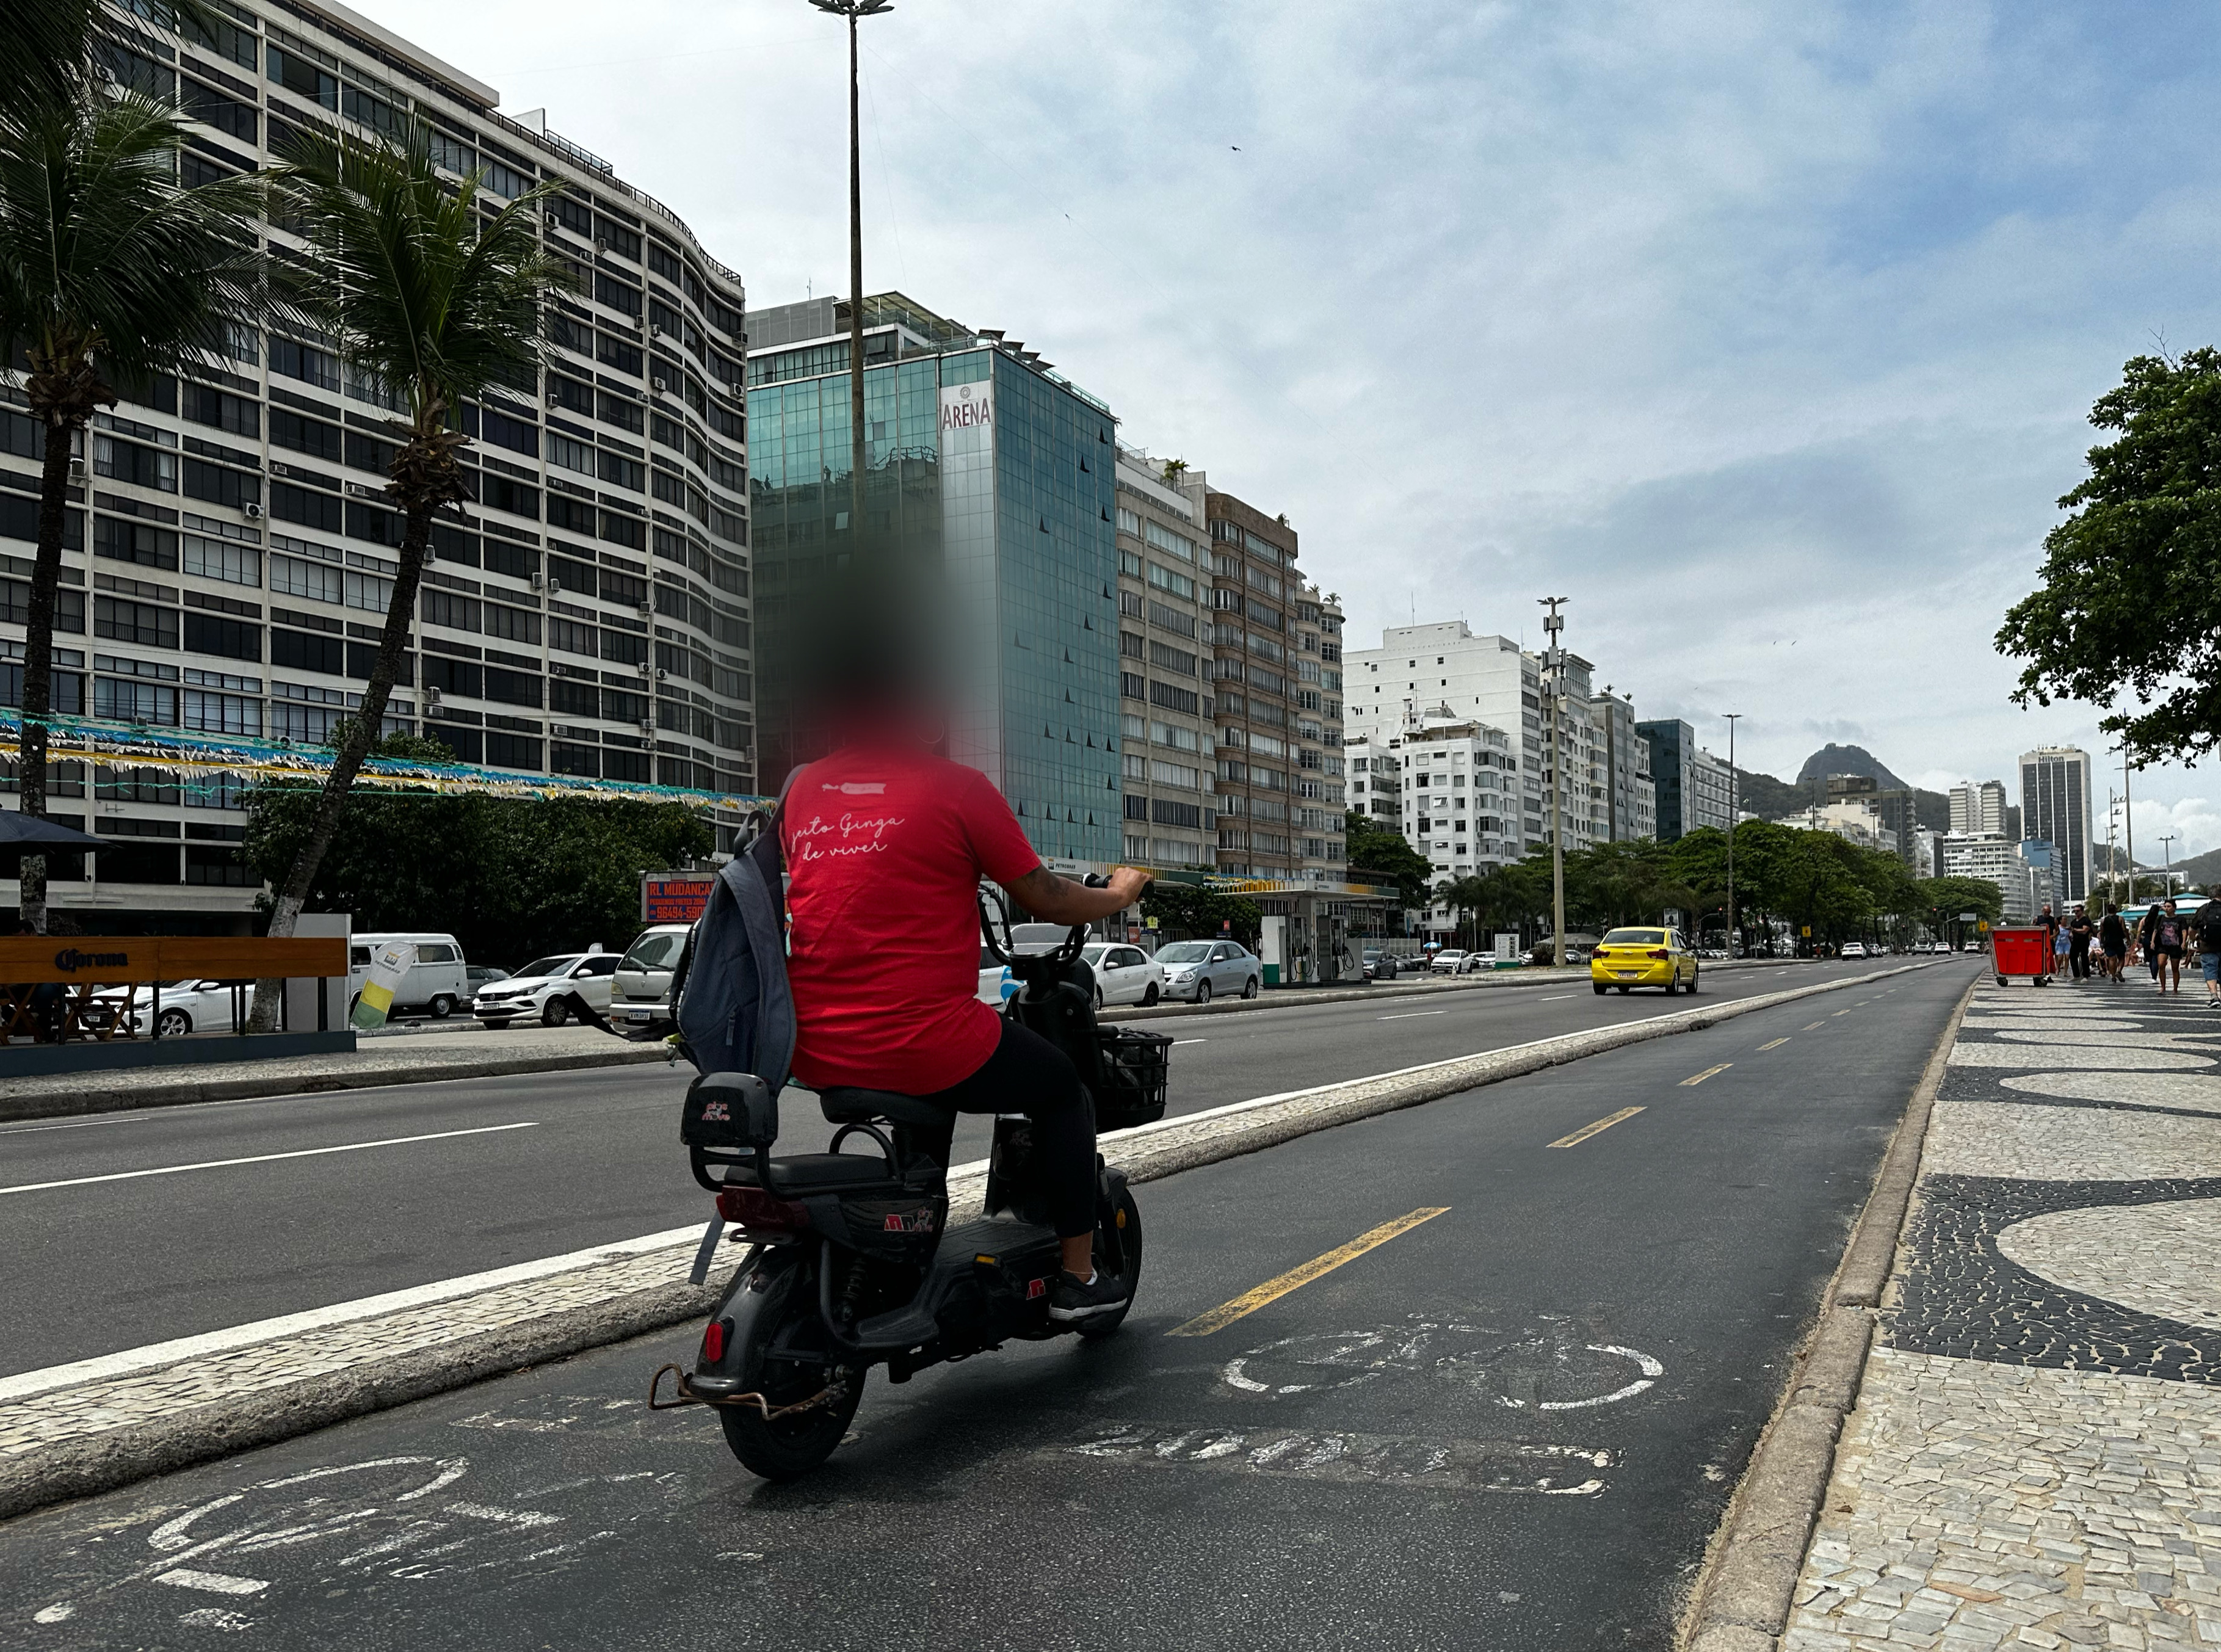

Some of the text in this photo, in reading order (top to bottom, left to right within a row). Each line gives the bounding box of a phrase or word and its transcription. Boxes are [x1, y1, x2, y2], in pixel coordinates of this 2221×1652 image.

[942, 397, 991, 430] ARENA
[839, 813, 905, 838] Ginga
[802, 841, 888, 861] de viver
[649, 883, 662, 896] RL
[55, 948, 129, 973] Corona
